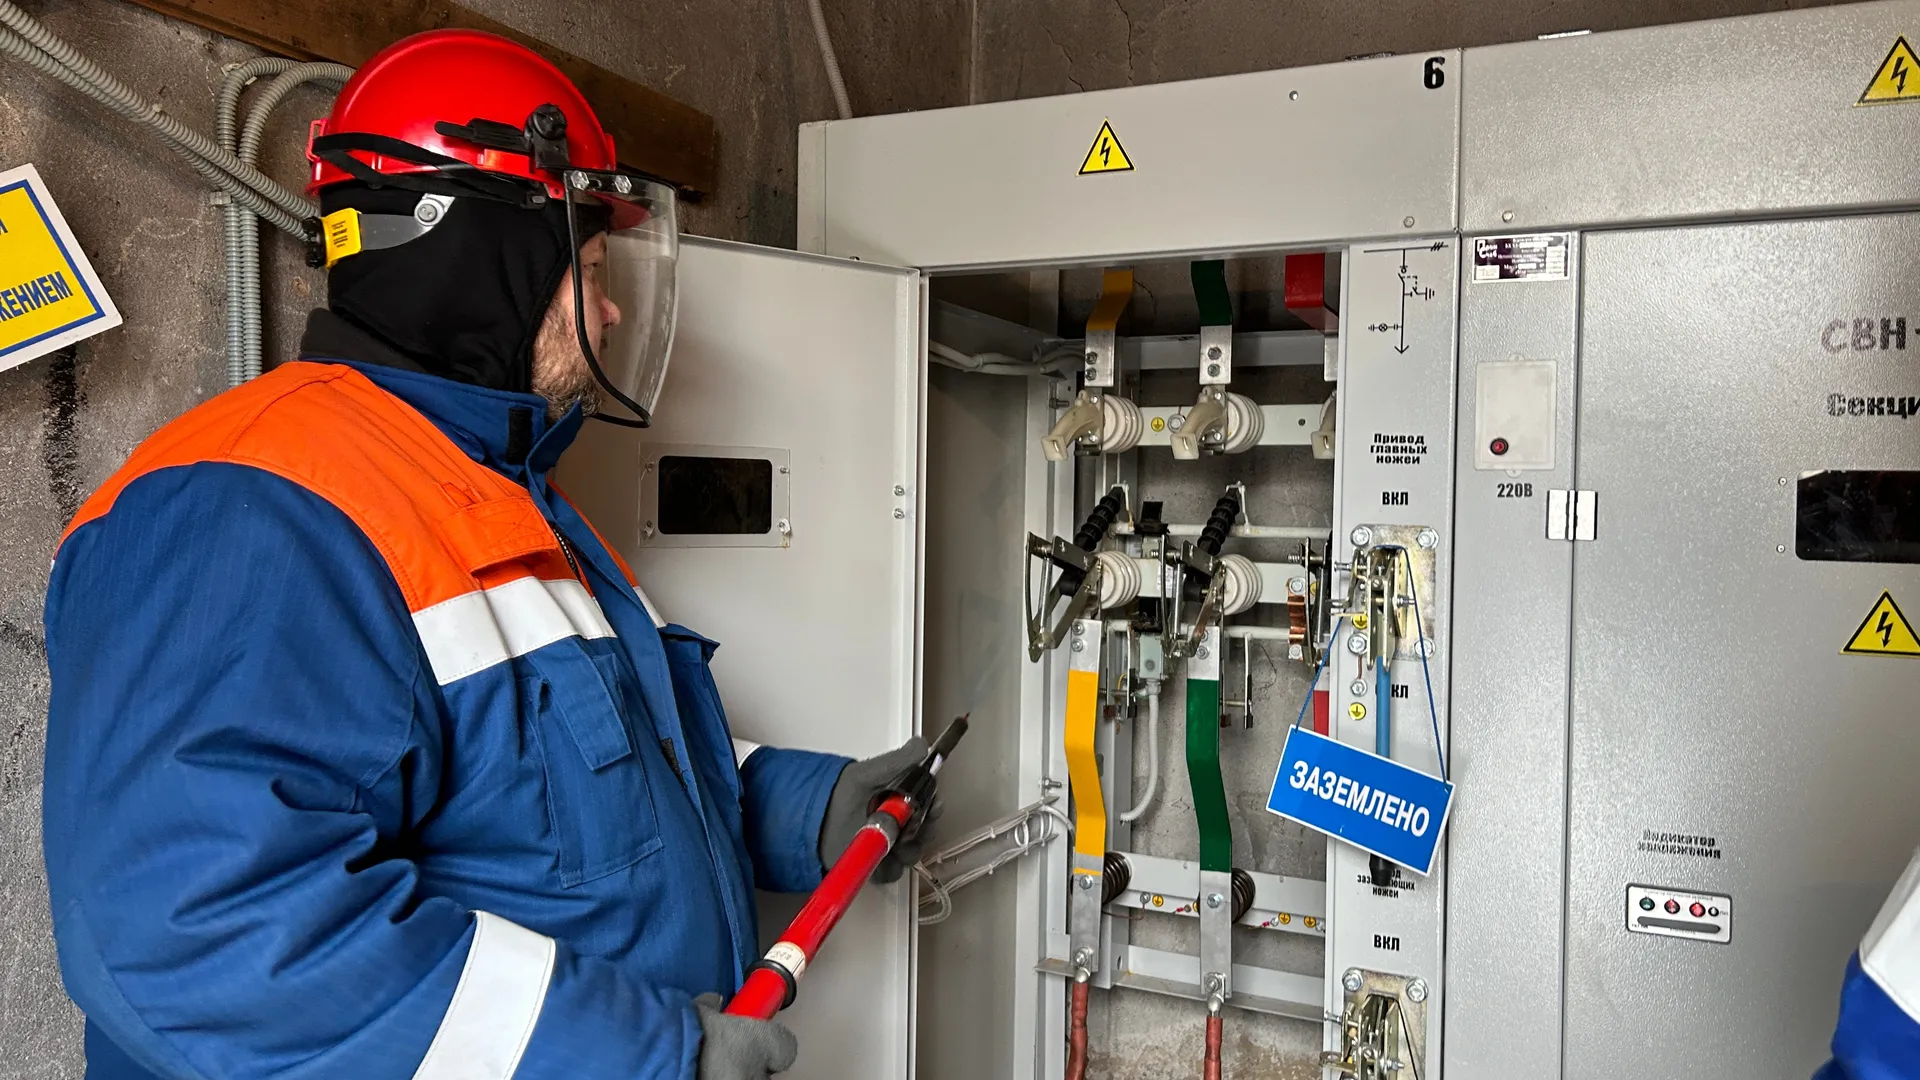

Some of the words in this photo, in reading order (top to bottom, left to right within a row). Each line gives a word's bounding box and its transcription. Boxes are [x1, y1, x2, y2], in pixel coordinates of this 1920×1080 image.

[1423, 56, 1446, 90] 6
[1373, 433, 1425, 446] Привод
[1370, 445, 1428, 455] главных
[1496, 482, 1533, 498] 220В
[1382, 491, 1409, 506] ВКЛ
[1289, 760, 1430, 838] ЗАЗЕМЛЕНО
[1373, 934, 1400, 952] ВКЛ
